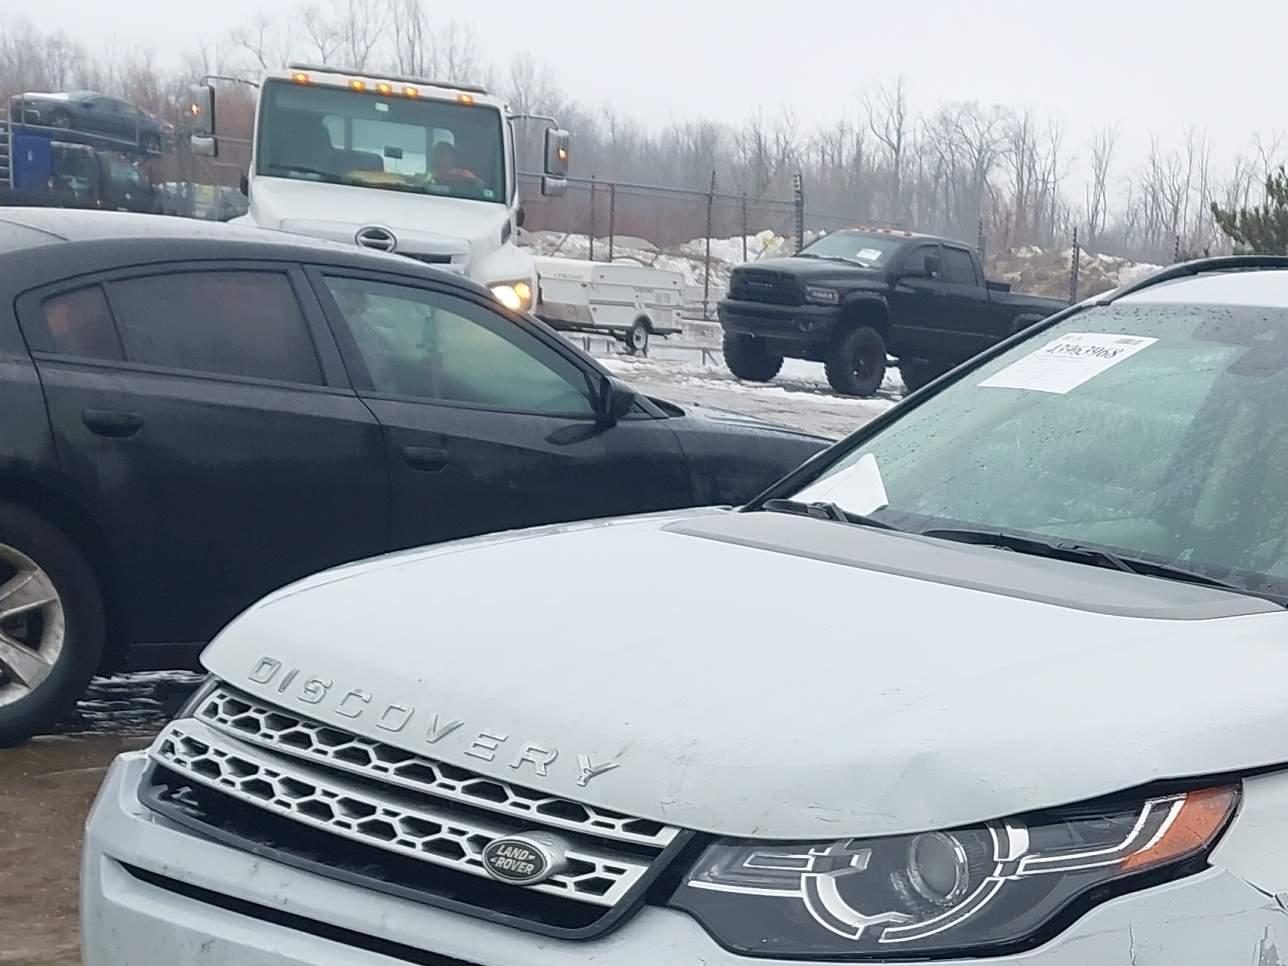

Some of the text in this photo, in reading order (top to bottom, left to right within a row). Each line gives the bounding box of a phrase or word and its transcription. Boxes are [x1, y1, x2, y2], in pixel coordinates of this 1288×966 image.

[247, 655, 621, 788] DISCOVERY
[496, 844, 530, 861] LAND
[494, 856, 535, 876] ROVER
